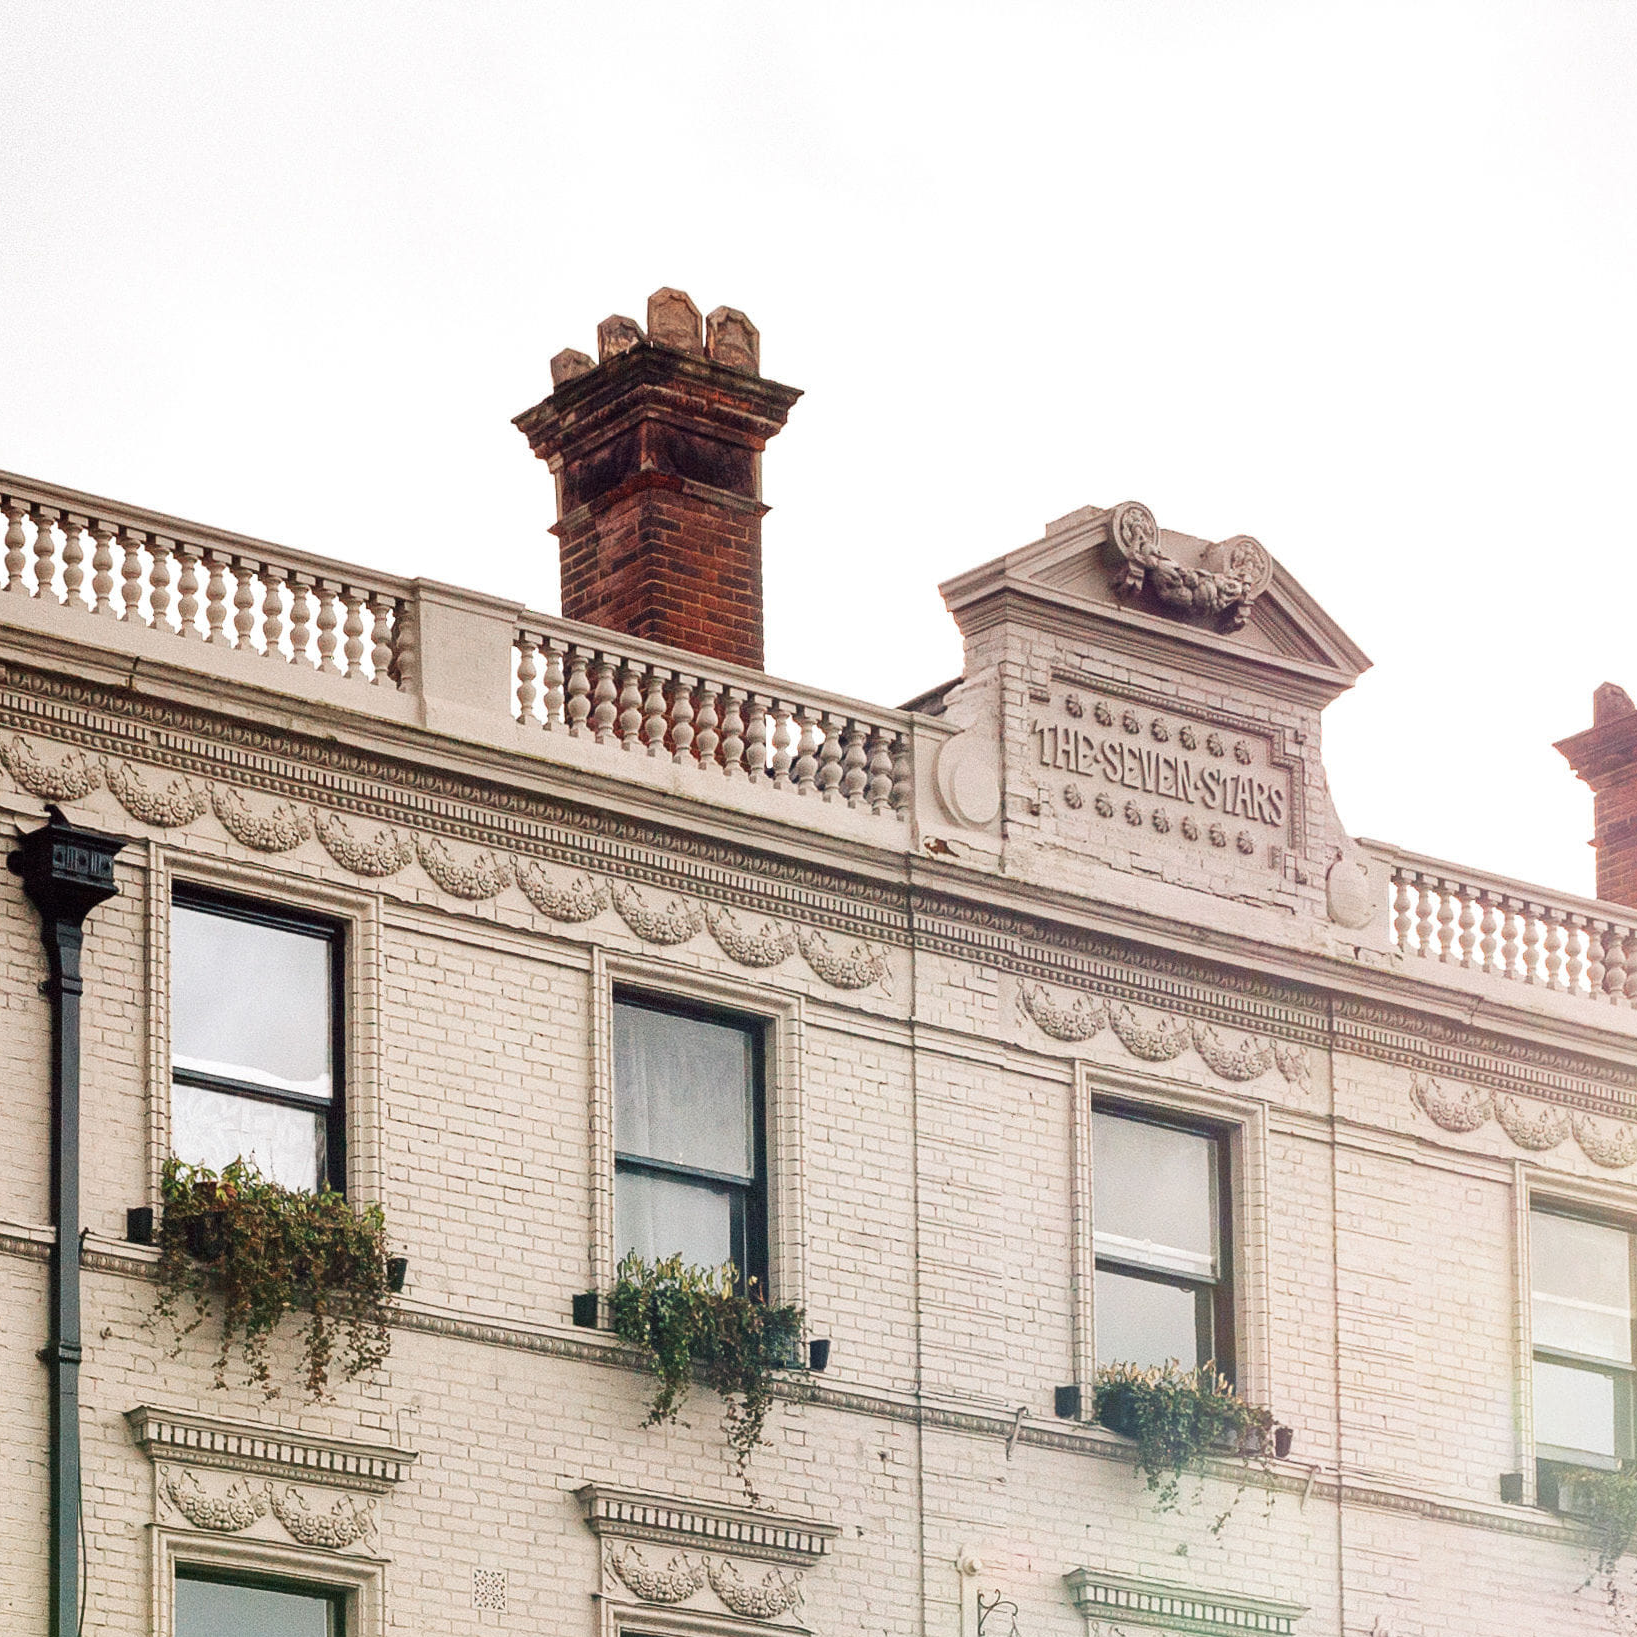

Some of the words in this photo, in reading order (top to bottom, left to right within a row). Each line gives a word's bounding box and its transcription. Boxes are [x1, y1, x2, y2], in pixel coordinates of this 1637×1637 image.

[1031, 719, 1094, 778] THE
[1102, 740, 1195, 804] SEVEN
[1202, 767, 1284, 828] STARS
